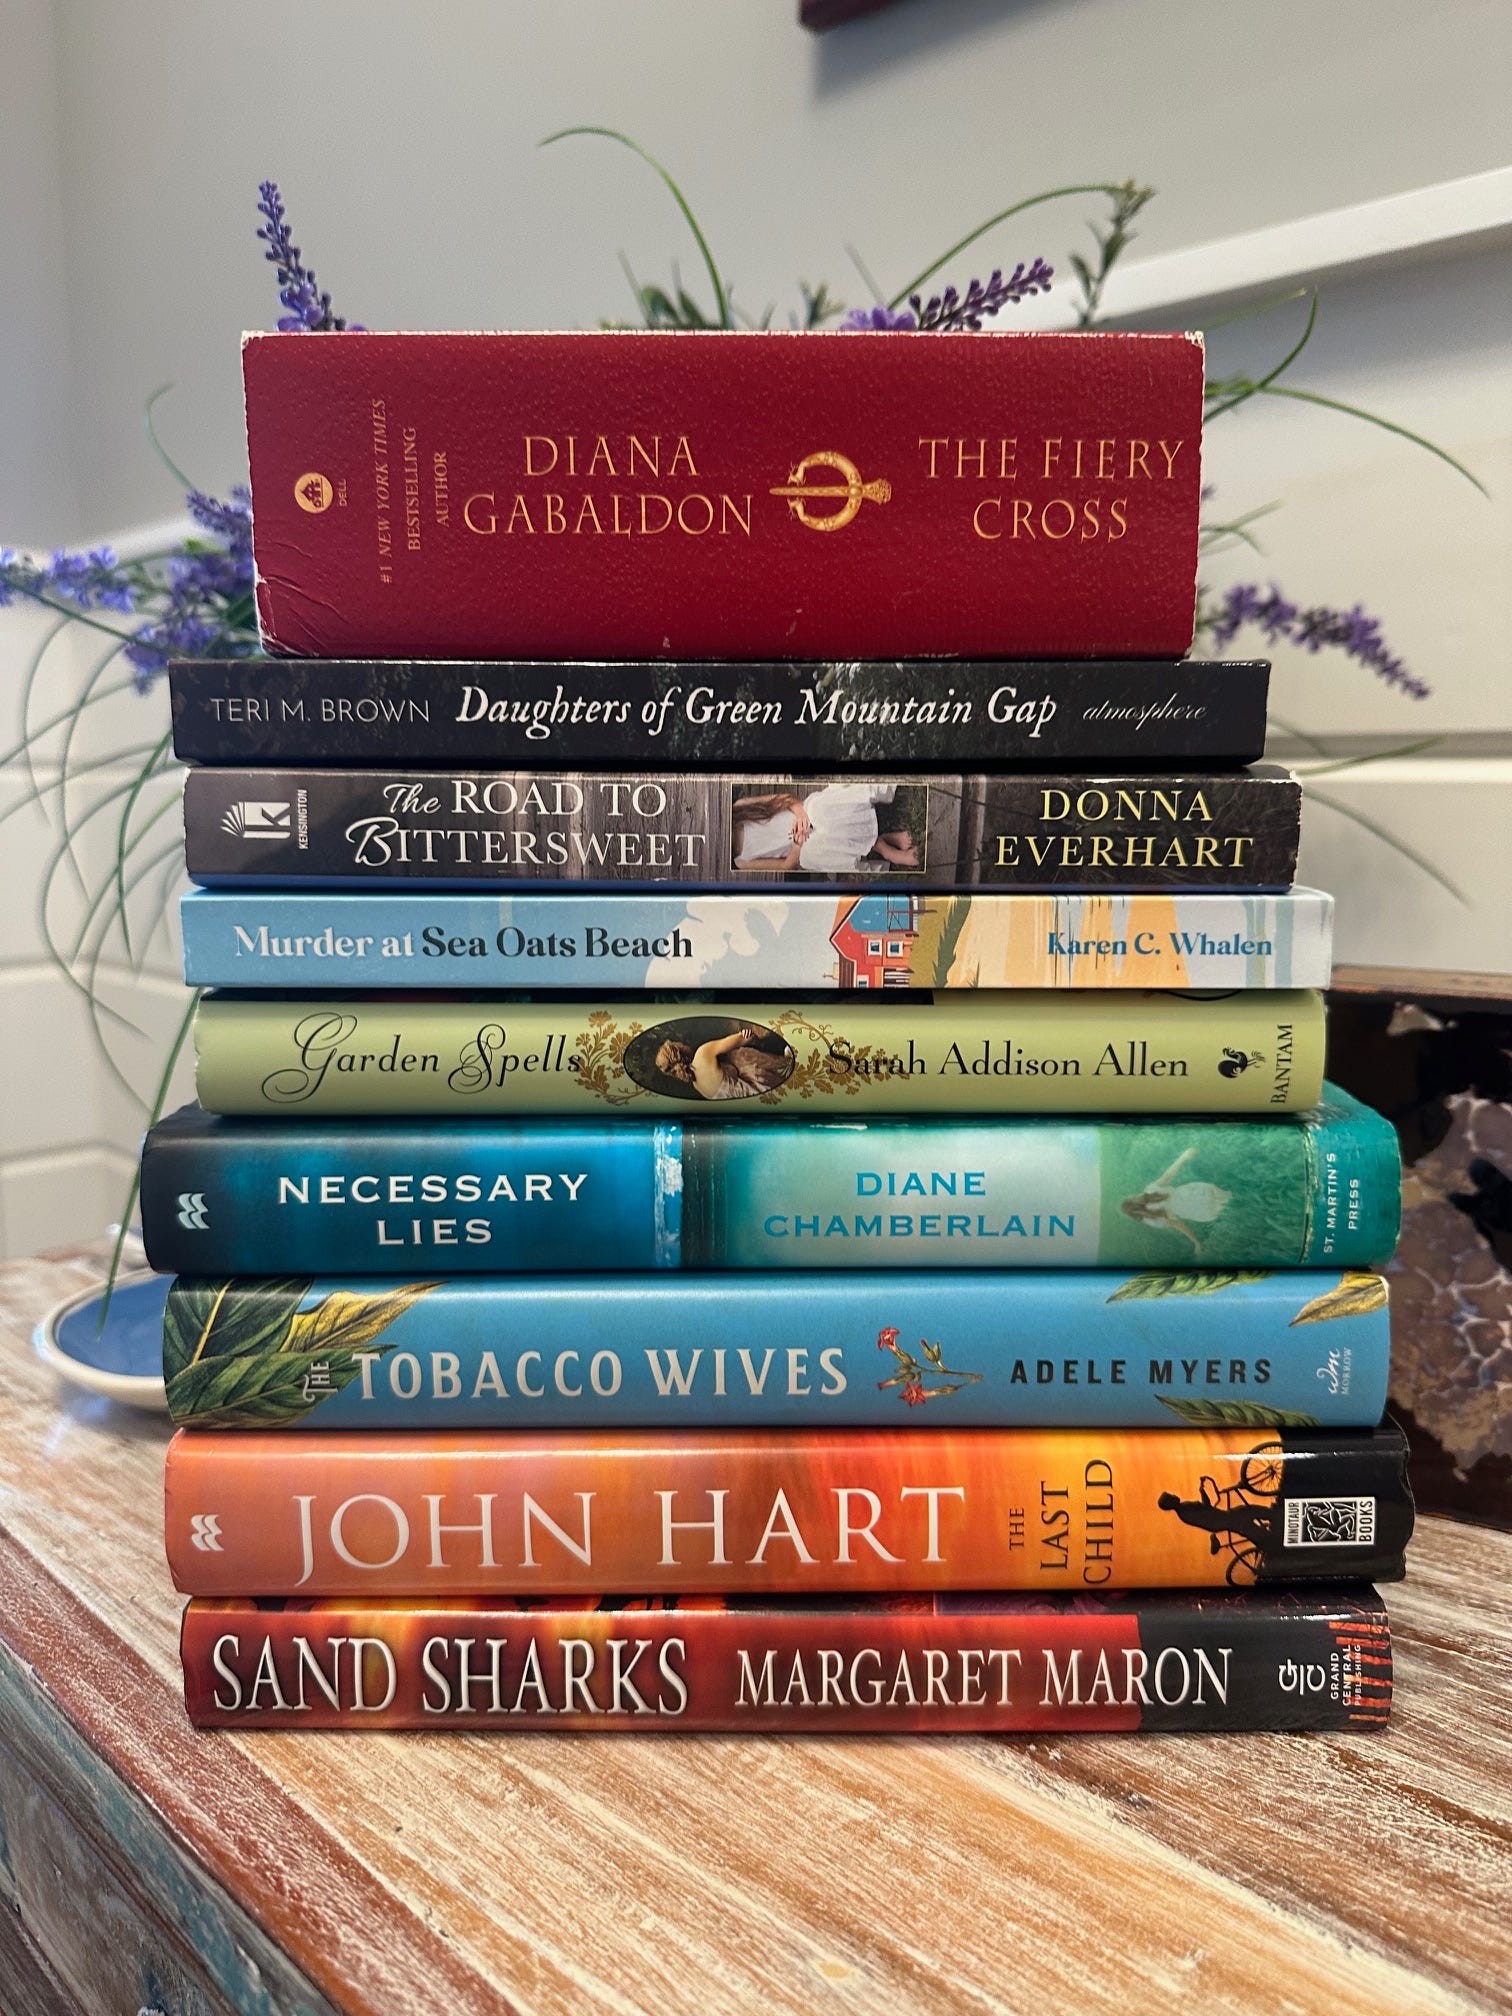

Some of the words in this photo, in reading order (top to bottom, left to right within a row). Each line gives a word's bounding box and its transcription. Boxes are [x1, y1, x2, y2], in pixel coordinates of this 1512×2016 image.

[372, 398, 389, 455] TIMES
[522, 434, 700, 477] DIANA
[917, 436, 1018, 481] THE
[1040, 435, 1185, 481] FIERY
[337, 478, 348, 507] DELL
[374, 461, 391, 511] YORK
[402, 426, 421, 551] BESTSELLING
[433, 450, 450, 528] AUTHOR
[377, 516, 393, 557] NEW
[463, 491, 752, 541] GABALDON
[971, 498, 1128, 544] CROSS
[380, 565, 393, 585] #1
[210, 697, 271, 723] TERI
[282, 698, 311, 723] M.
[321, 698, 431, 724] BROWN
[455, 685, 629, 739] Daughters
[640, 685, 675, 736] of
[685, 686, 783, 725] Green
[794, 687, 974, 726] Mountain
[987, 686, 1058, 738] Gap
[1082, 691, 1208, 731] atmosphere
[297, 788, 309, 850] KENSINGTON
[383, 782, 443, 815] The
[451, 780, 585, 818] ROAD
[599, 783, 667, 819] TO
[1040, 788, 1214, 822] DONNA
[345, 815, 706, 868] BITTERSWEET
[995, 834, 1255, 869] EVERHART
[233, 924, 374, 959] Murder
[381, 926, 416, 958] at
[421, 925, 488, 958] Sea
[495, 925, 577, 959] Oats
[584, 926, 694, 959] Beach
[1046, 930, 1129, 957] Karen
[1133, 932, 1162, 957] C.
[1169, 931, 1273, 957] Whalen
[261, 1011, 441, 1105] Garden
[447, 1023, 584, 1095] Spells
[827, 1039, 928, 1077] Sarah
[937, 1041, 1083, 1077] Addison
[1092, 1040, 1189, 1077] Allen
[1270, 1023, 1294, 1105] BANTAM
[276, 1172, 590, 1205] NECESSARY
[855, 1170, 988, 1198] DIANE
[1326, 1152, 1338, 1229] MARTIN'S
[1348, 1178, 1360, 1230] PRESS
[376, 1218, 493, 1246] LIES
[762, 1213, 1077, 1239] CHAMBERLAIN
[1323, 1233, 1335, 1253] ST.
[302, 1360, 339, 1403] THE
[351, 1350, 624, 1401] TOBACCO
[644, 1346, 849, 1398] WIVES
[1009, 1358, 1127, 1385] ADELE
[1147, 1357, 1273, 1385] MYERS
[1341, 1346, 1352, 1395] MORROW
[292, 1490, 598, 1588] JOHN
[652, 1486, 965, 1567] HART
[1008, 1506, 1026, 1552] THE
[1039, 1480, 1071, 1571] LAST
[1083, 1458, 1115, 1586] CHILD
[1287, 1501, 1300, 1544] MINOTAUR
[1359, 1500, 1373, 1542] BOOKS
[211, 1633, 398, 1713] SAND
[421, 1635, 689, 1717] SHARKS
[734, 1647, 1023, 1708] MARGARET
[1041, 1646, 1234, 1708] MARON
[1330, 1652, 1340, 1700] GRAND
[1342, 1644, 1352, 1706] CENTRAL
